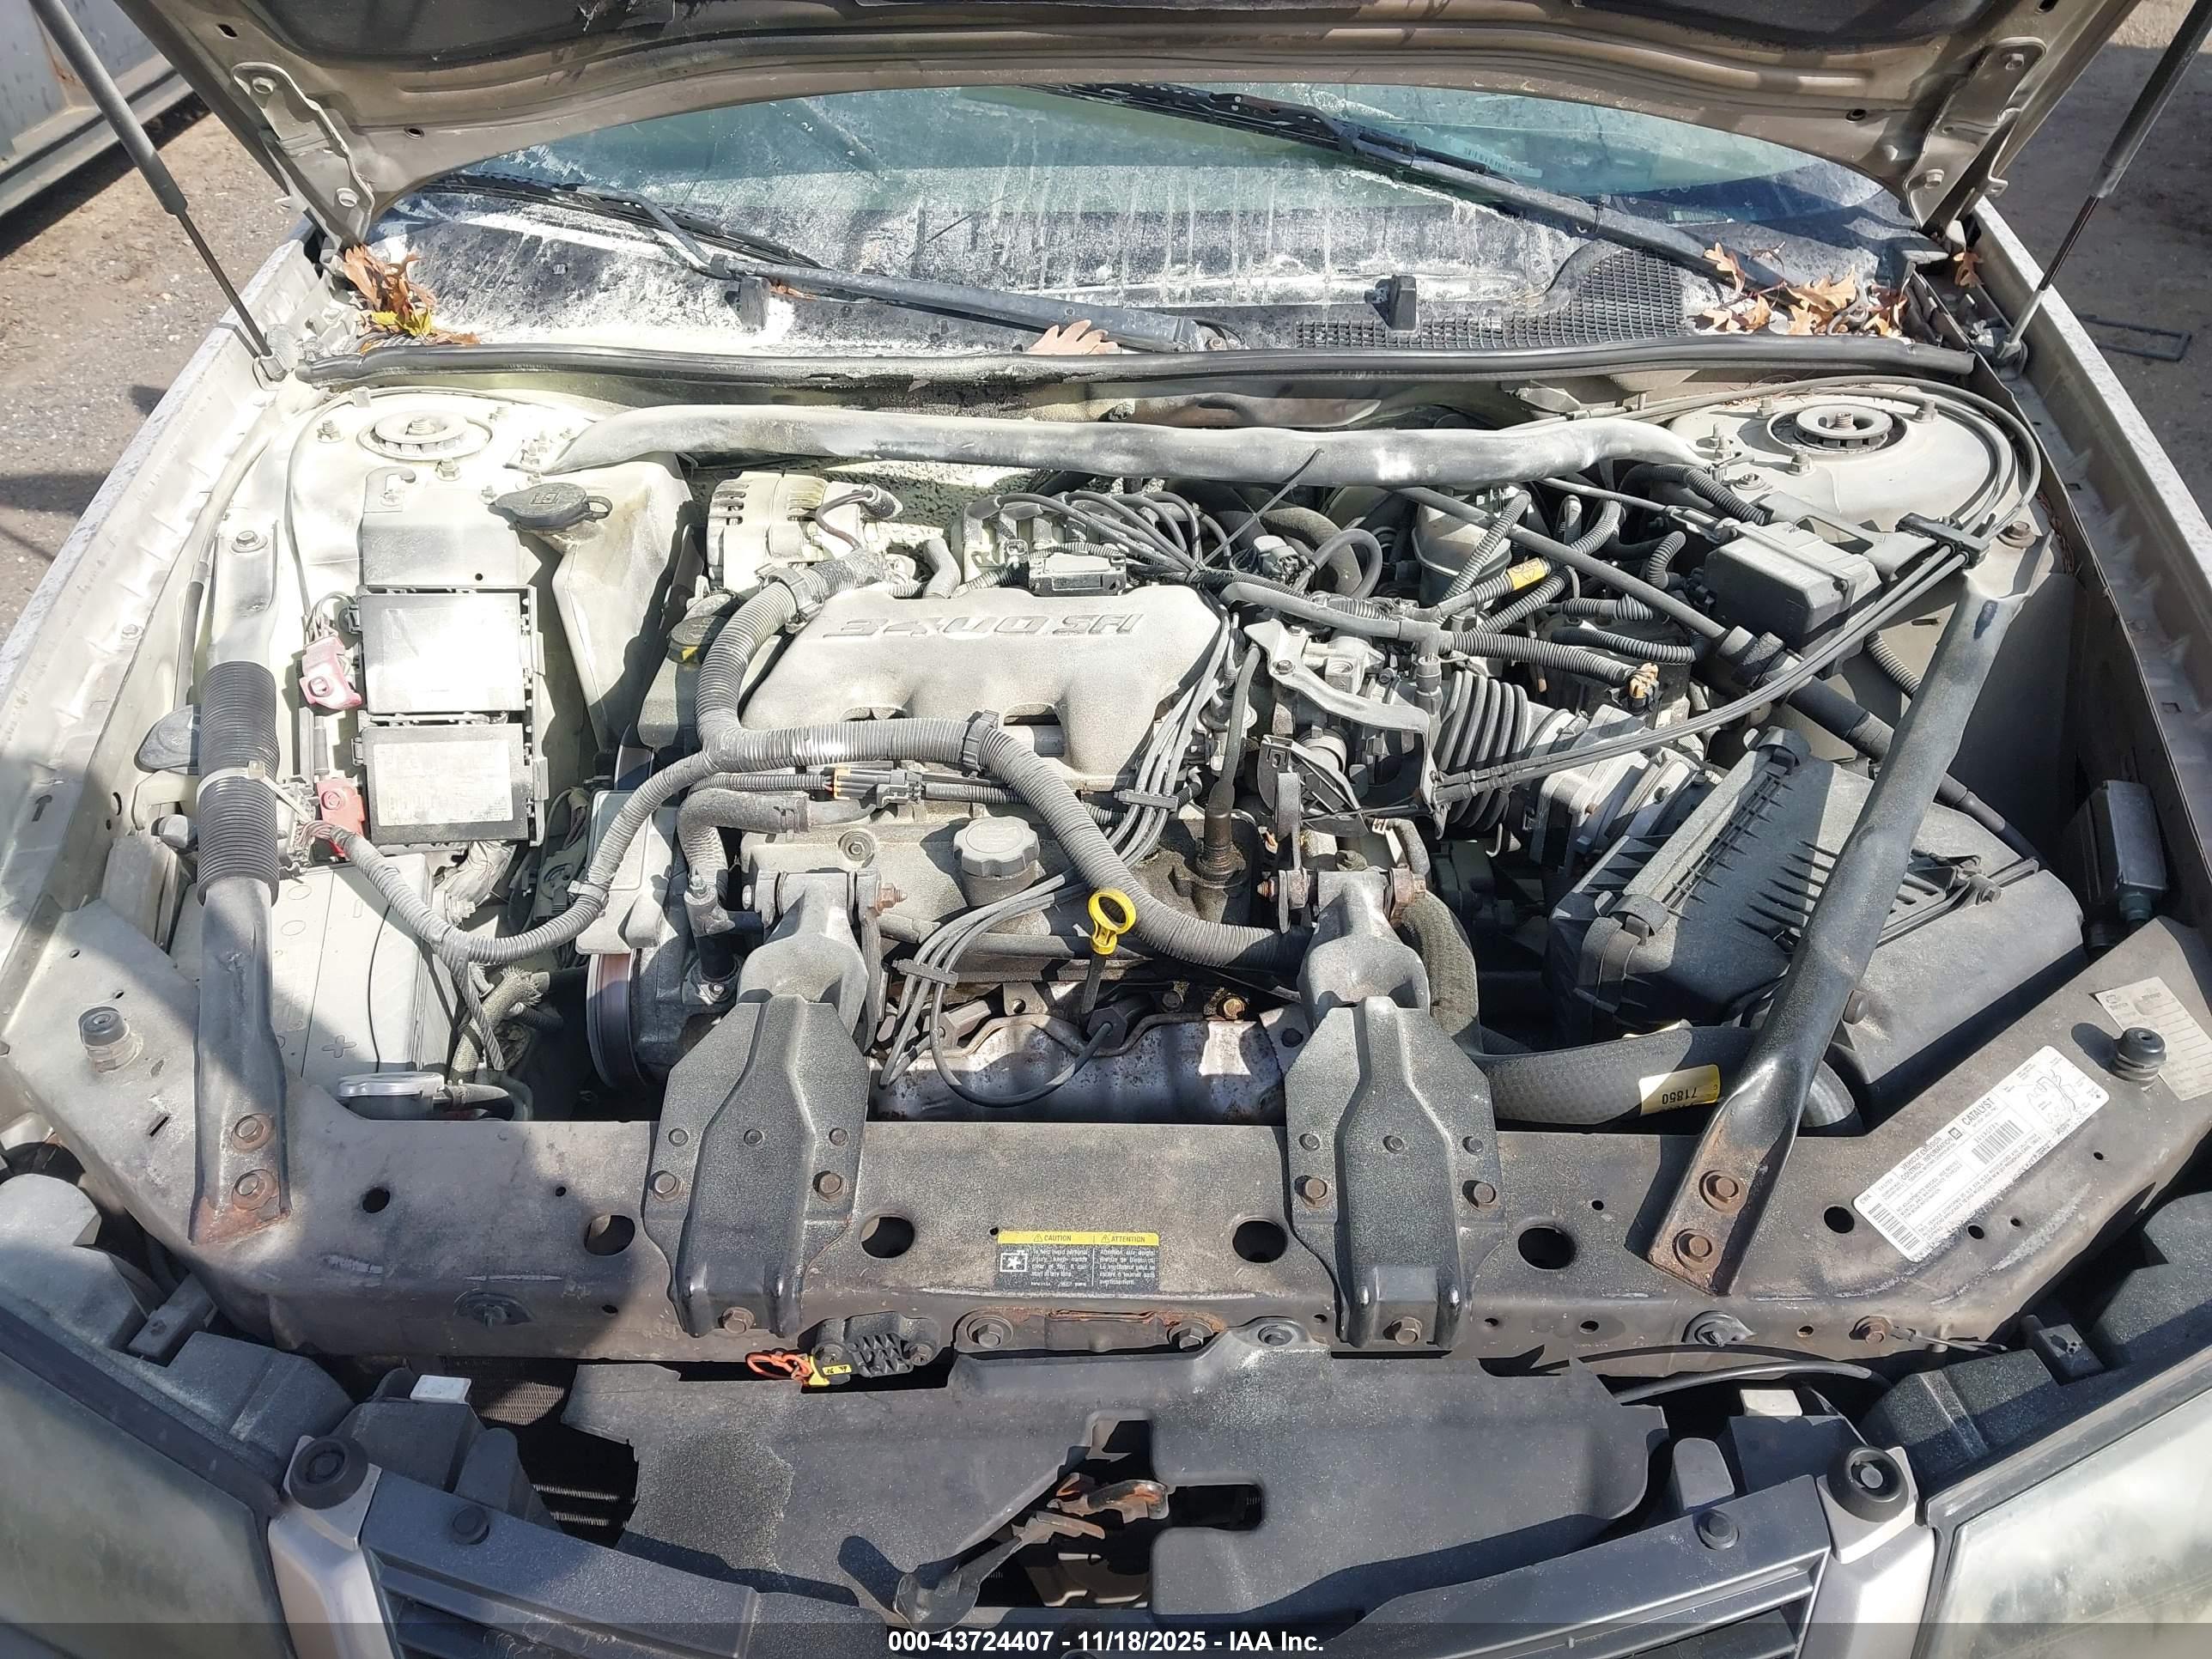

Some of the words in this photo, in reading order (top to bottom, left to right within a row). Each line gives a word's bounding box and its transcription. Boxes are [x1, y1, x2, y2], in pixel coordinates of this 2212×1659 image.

[823, 616, 1050, 640] 3400
[1053, 613, 1145, 636] SFI
[1662, 1087, 1698, 1105] 71850
[1960, 1097, 1996, 1127] CATALYST
[1899, 1160, 1923, 1180] CONTROL
[1921, 1135, 1954, 1162] INFORMATION
[1900, 1152, 1922, 1170] VEHICLE
